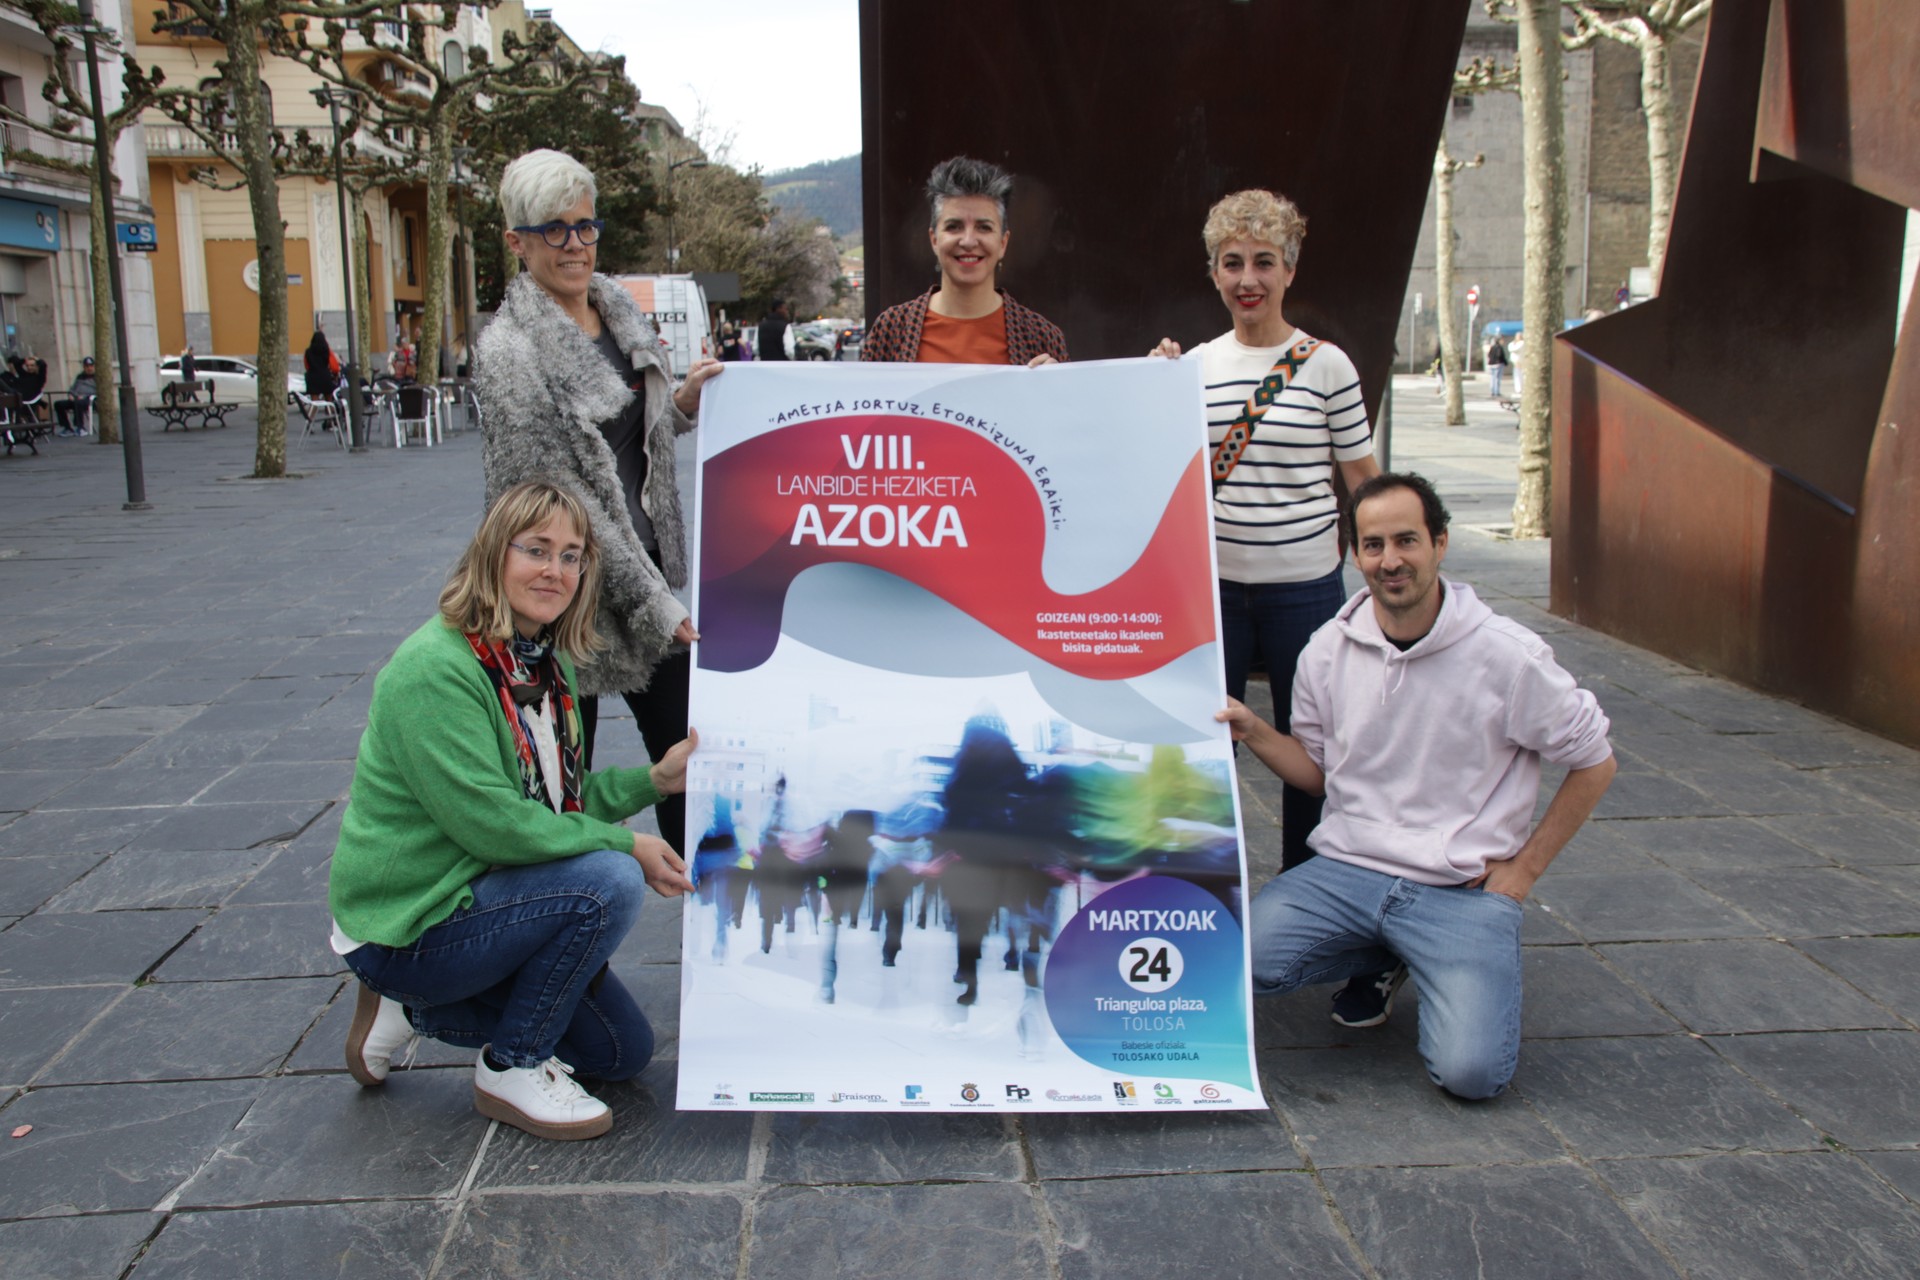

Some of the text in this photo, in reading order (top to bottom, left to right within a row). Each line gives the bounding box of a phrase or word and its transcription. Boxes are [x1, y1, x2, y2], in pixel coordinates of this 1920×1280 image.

[852, 399, 925, 416] SORTUZ,
[840, 434, 925, 470] VIII.
[777, 475, 977, 497] LANBIDE HEZIKETA
[790, 503, 969, 547] AZOKA
[1036, 612, 1162, 625] GOIZEAN (9:00-14:00):
[1037, 629, 1164, 640] Ikastetxeetako ikasleen
[1062, 642, 1143, 655] bisita gidatuak.
[1088, 910, 1218, 931] MARTXOAK
[1129, 947, 1171, 982] 24
[1095, 997, 1208, 1014] Trianguloa plaza,
[1121, 1016, 1186, 1031] TOLOSA
[1112, 1052, 1200, 1062] TOLOSAKO UDALA
